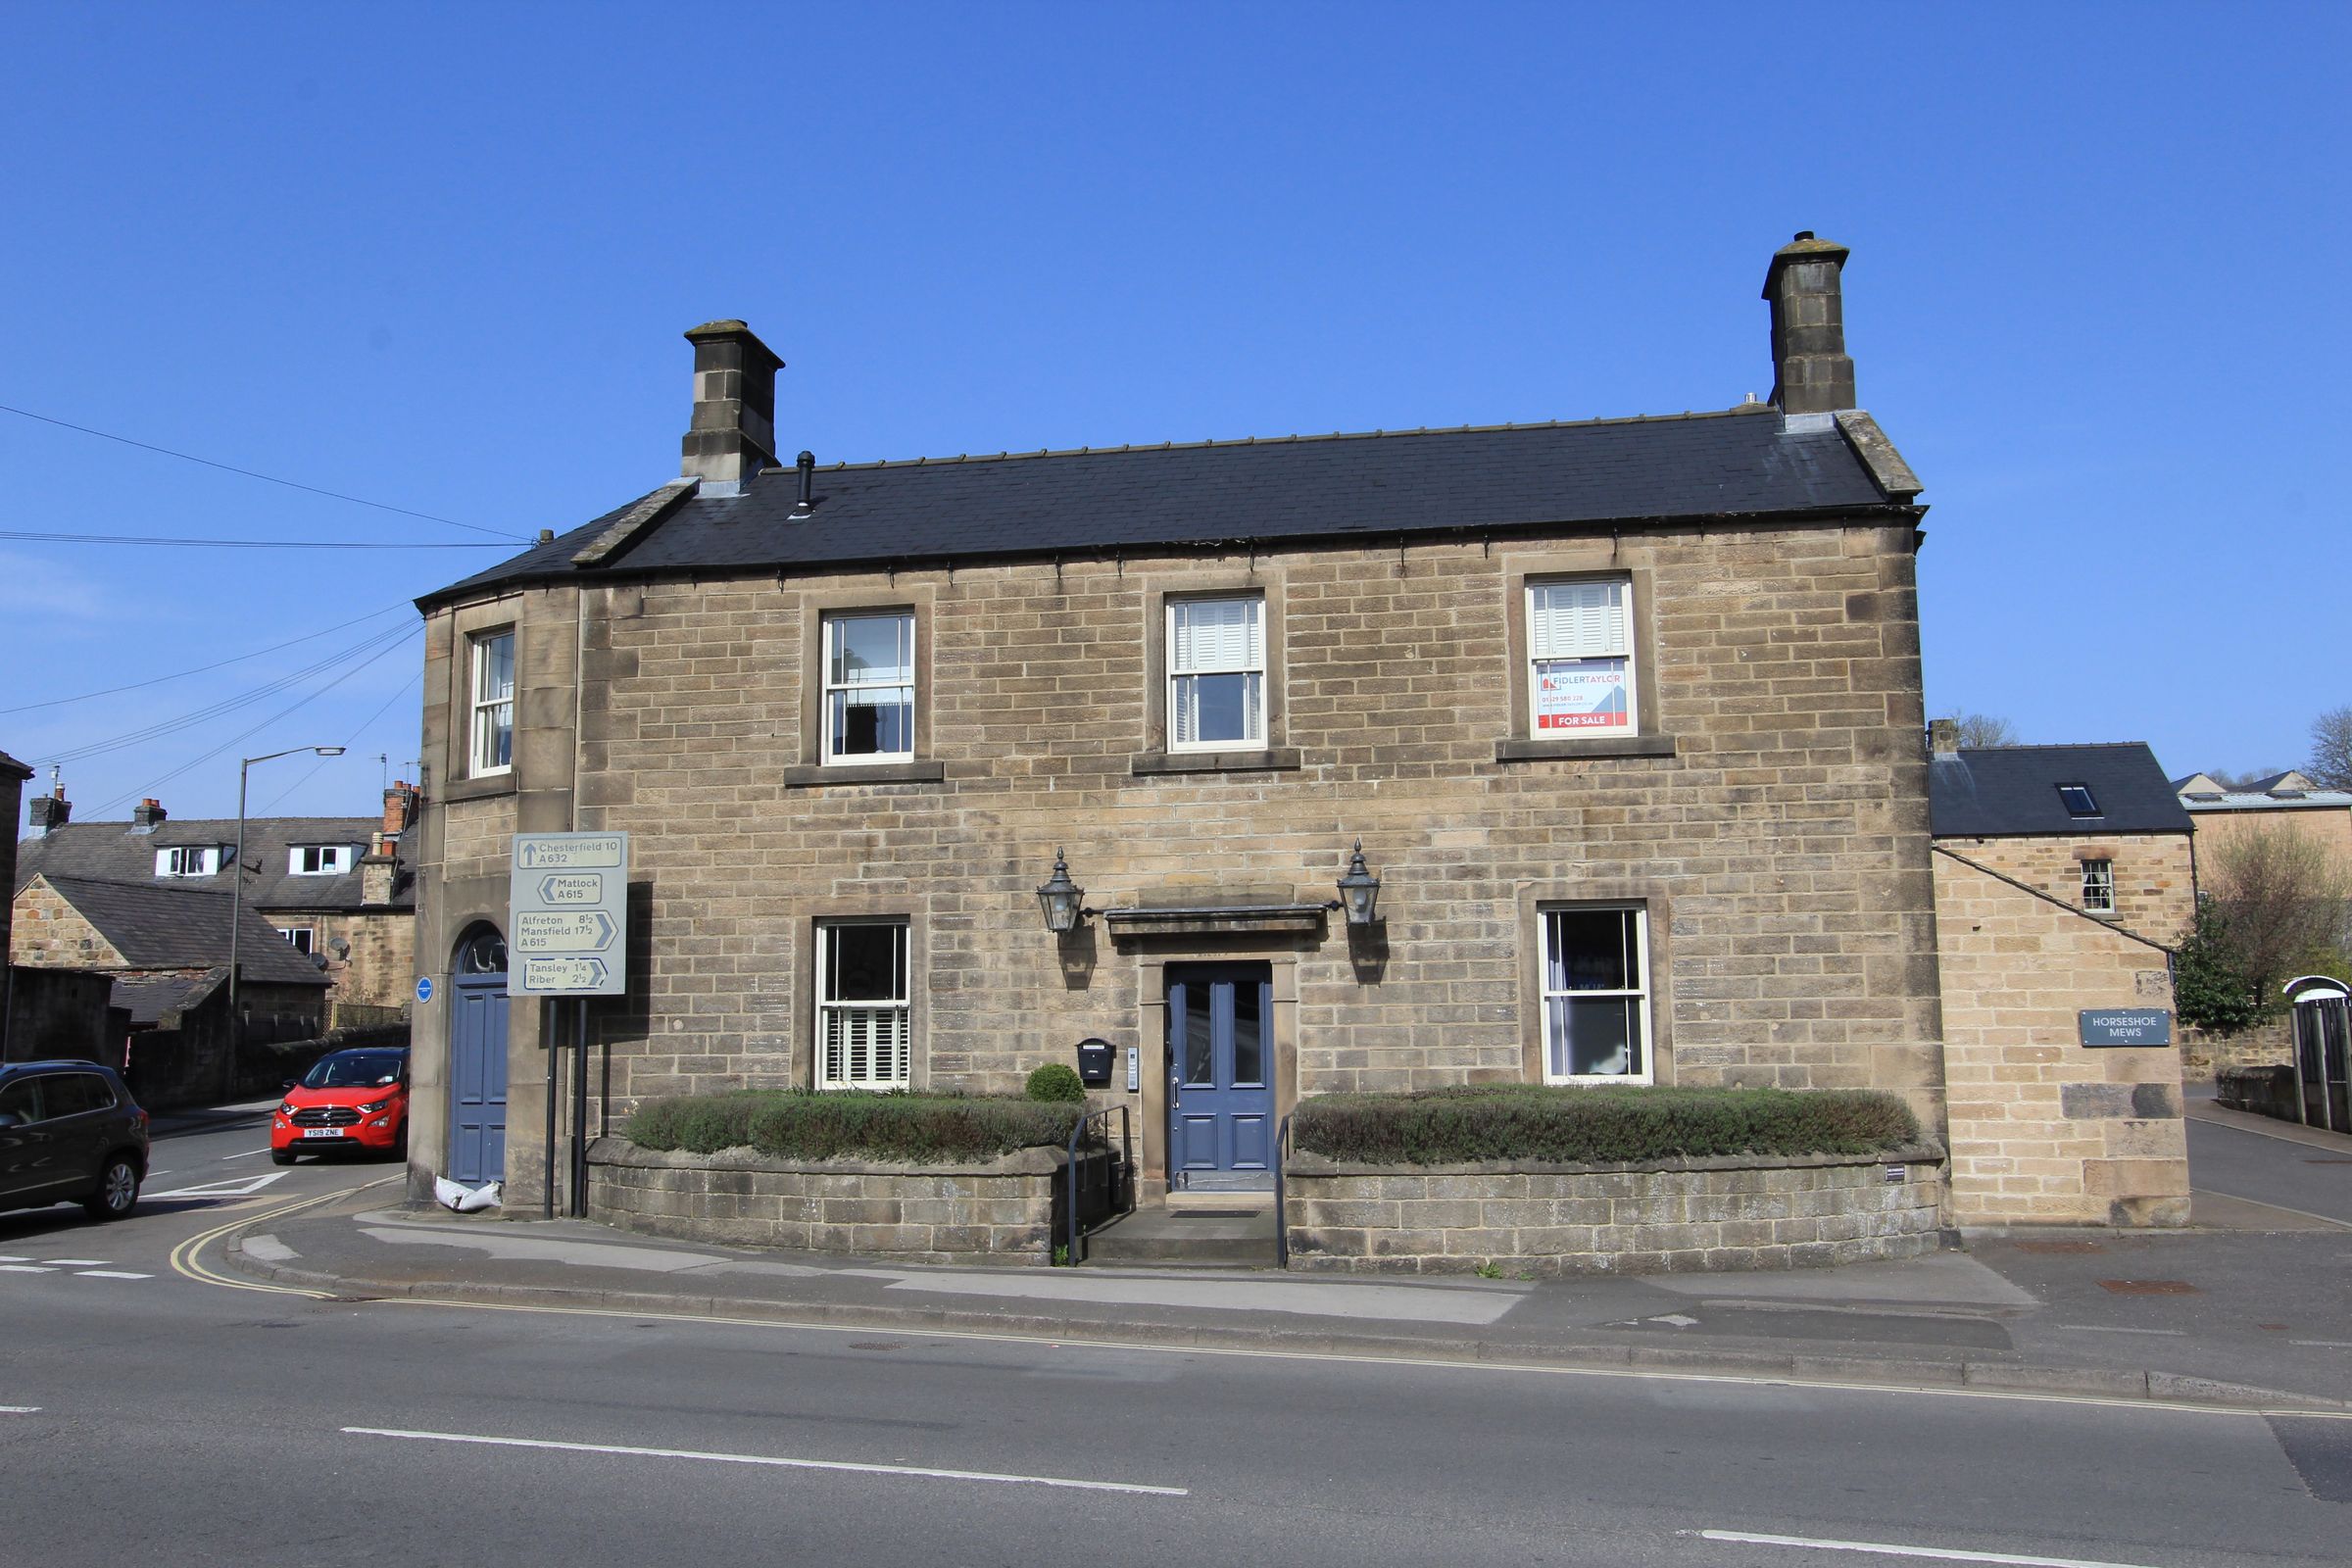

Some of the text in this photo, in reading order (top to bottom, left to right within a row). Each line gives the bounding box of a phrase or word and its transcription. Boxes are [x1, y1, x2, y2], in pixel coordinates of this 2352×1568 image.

[1558, 715, 1605, 725] FOR SALE
[539, 842, 617, 853] Chesterfield 10
[520, 926, 571, 936] Mansfield
[530, 963, 567, 973] Tansley
[529, 975, 556, 984] Riber
[2092, 1016, 2157, 1026] HORSESHOE
[2109, 1028, 2141, 1037] MEWS
